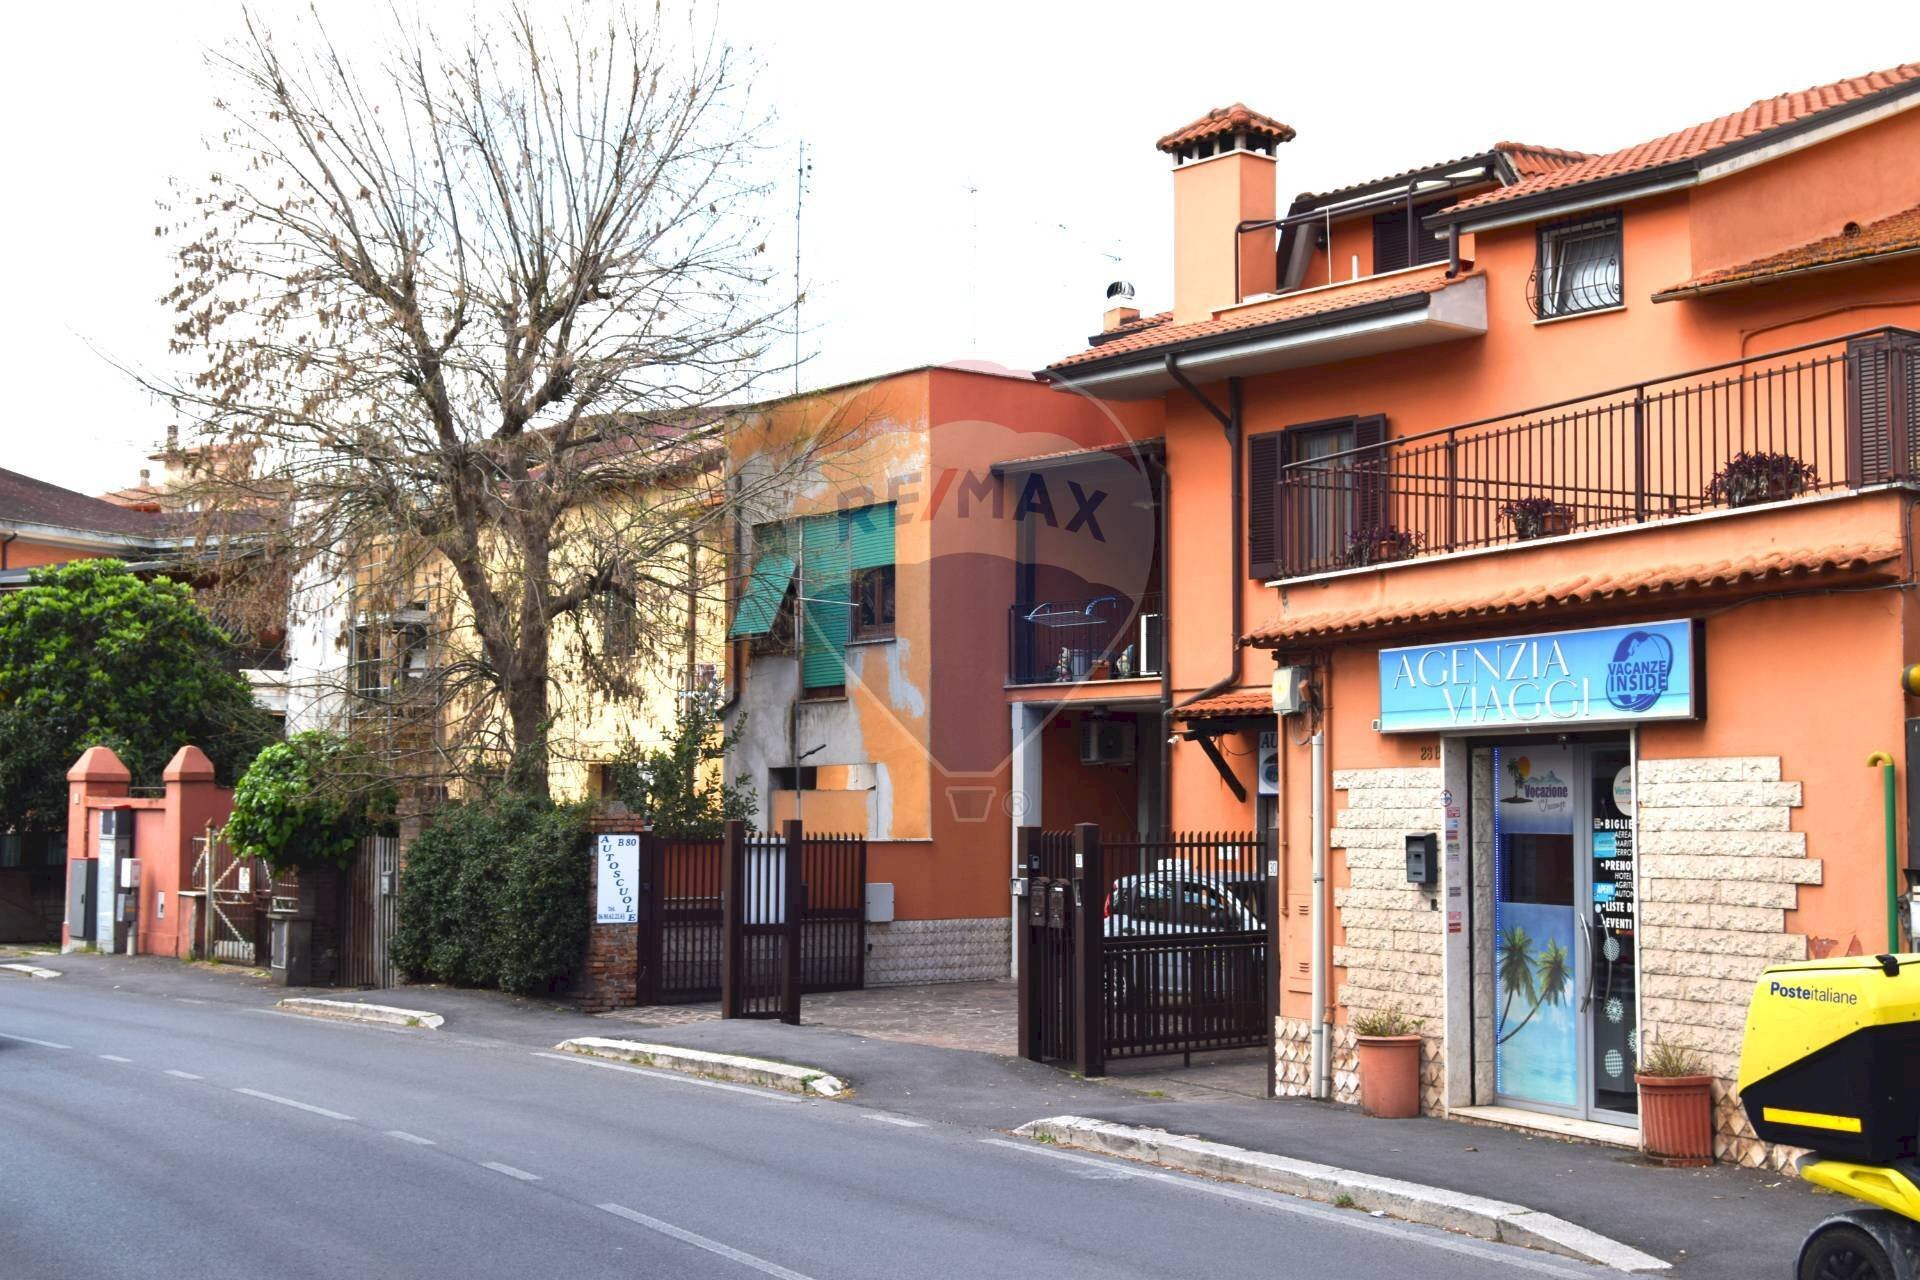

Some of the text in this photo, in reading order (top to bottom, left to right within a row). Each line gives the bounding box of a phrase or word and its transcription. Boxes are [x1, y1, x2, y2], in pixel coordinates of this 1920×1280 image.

[1393, 639, 1570, 690] AGENZIA
[1607, 660, 1667, 676] VACANZE
[1610, 673, 1668, 692] INSIDE
[1442, 678, 1590, 723] VIAGGI
[1524, 784, 1568, 798] Vocazione
[1605, 902, 1625, 912] LISTE
[1606, 917, 1632, 929] EVENTI
[1770, 981, 1857, 1005] Posteitaliane
